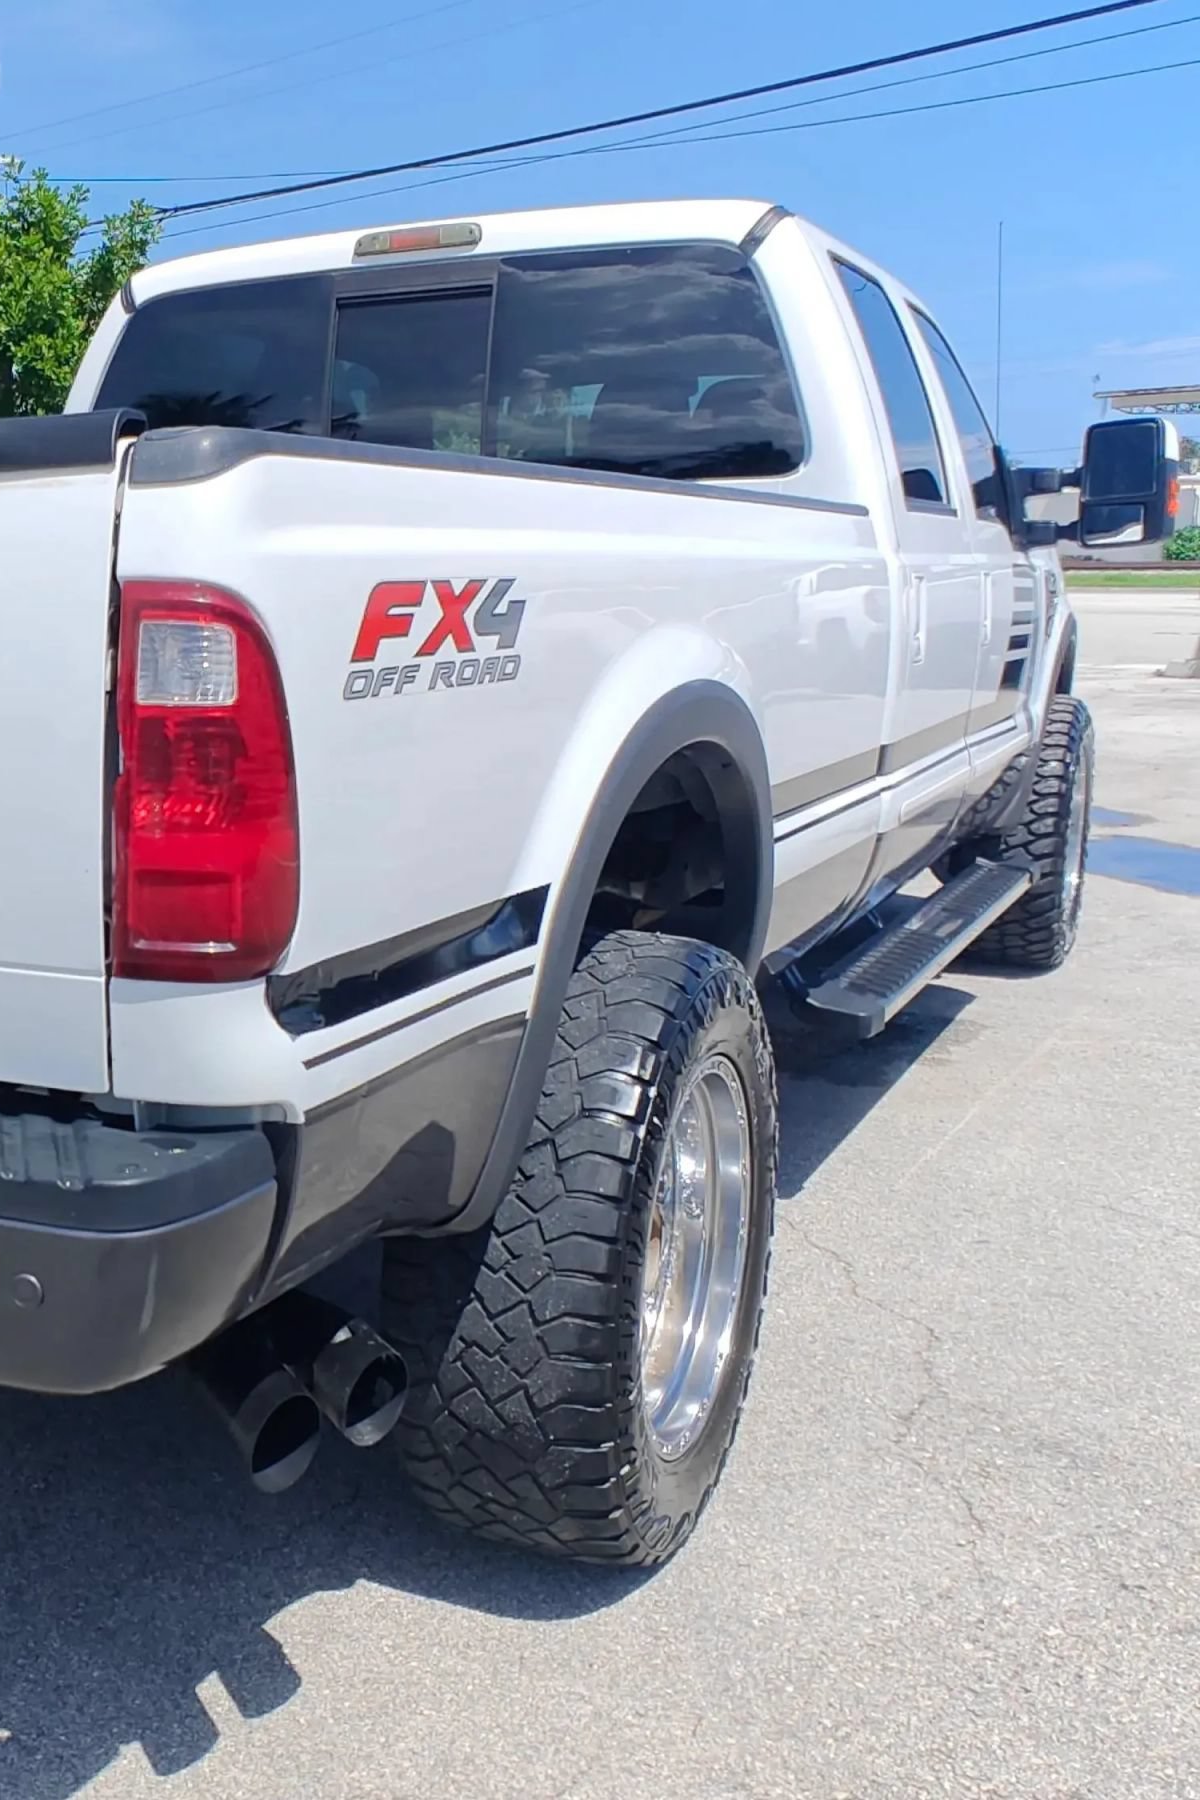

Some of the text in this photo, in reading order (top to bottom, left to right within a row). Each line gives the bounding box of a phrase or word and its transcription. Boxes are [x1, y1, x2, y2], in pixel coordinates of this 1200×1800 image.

[350, 577, 526, 663] FX4
[343, 654, 521, 700] OFF ROAD
